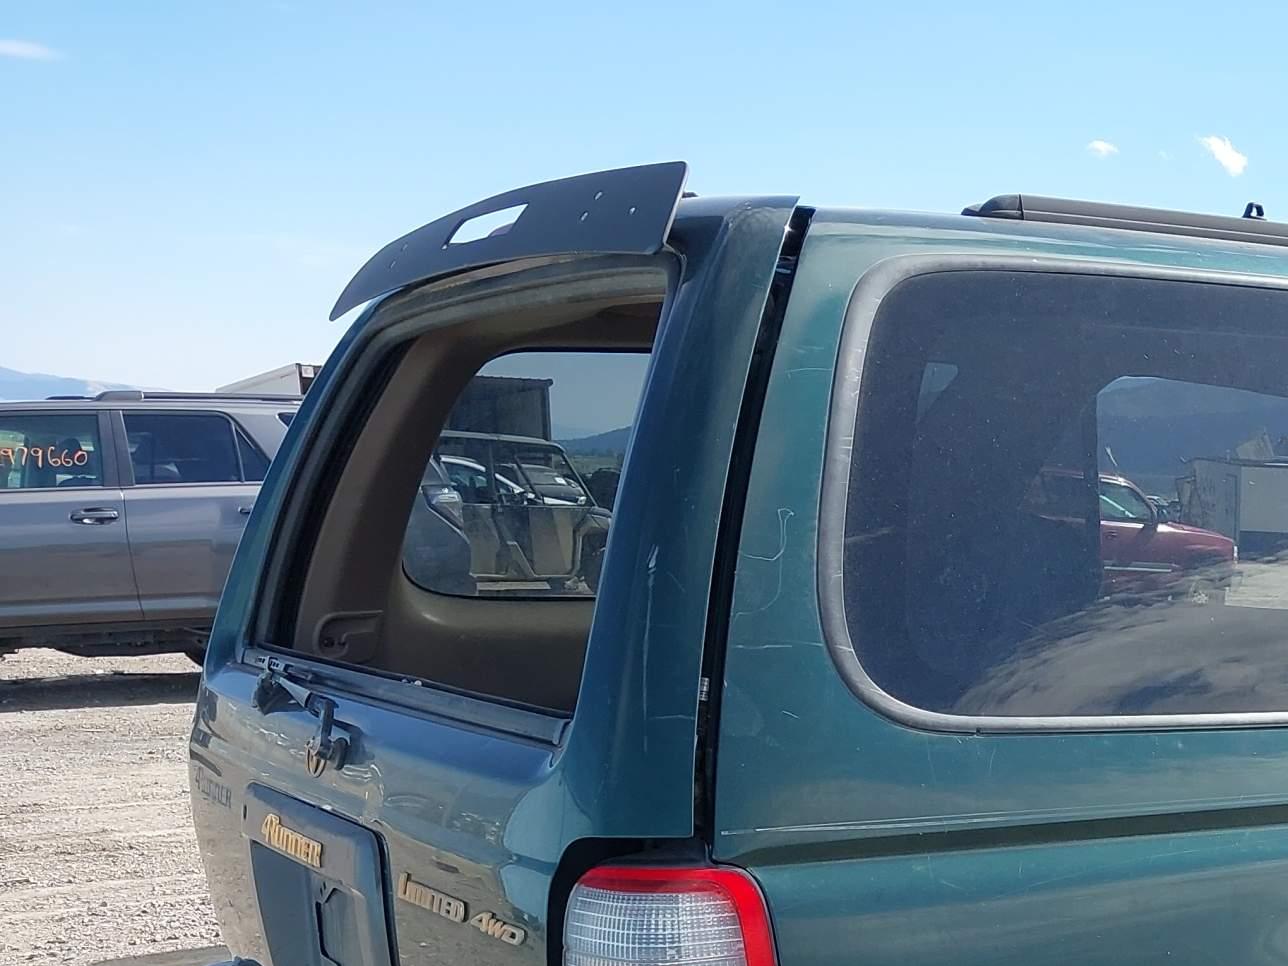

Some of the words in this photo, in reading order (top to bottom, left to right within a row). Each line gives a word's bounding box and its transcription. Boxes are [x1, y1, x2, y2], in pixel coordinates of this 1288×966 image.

[0, 446, 89, 470] 979660
[397, 870, 467, 923] LIMITED
[470, 909, 526, 946] 4WD
